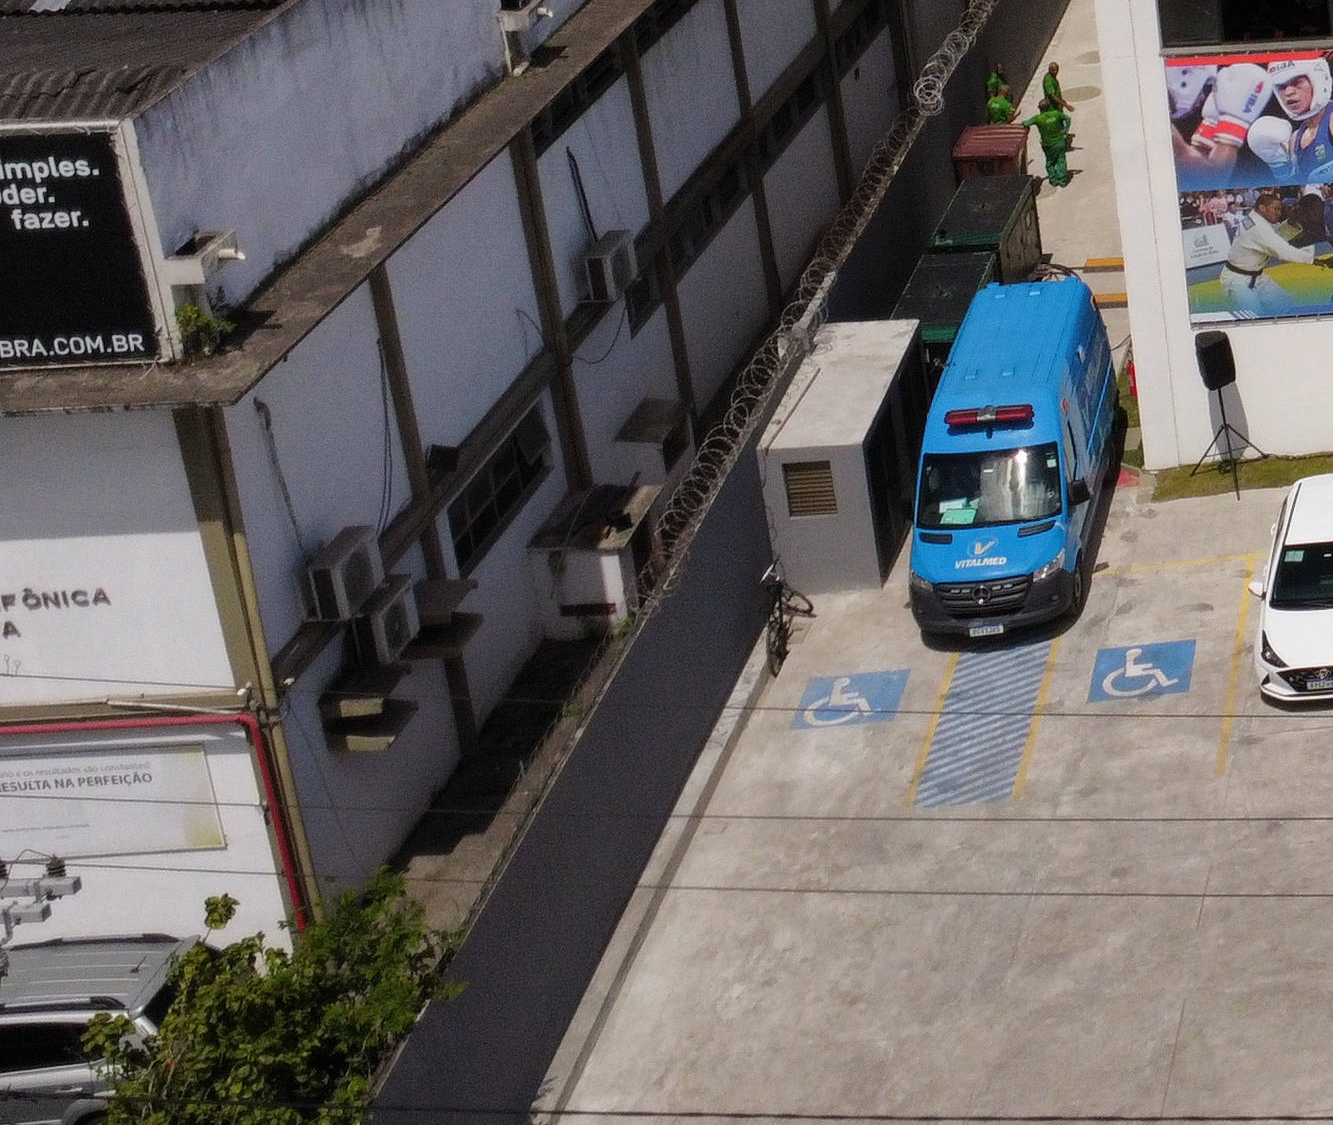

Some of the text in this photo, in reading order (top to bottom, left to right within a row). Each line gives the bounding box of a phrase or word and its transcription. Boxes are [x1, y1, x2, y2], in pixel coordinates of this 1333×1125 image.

[0, 157, 100, 182] imples.
[11, 209, 90, 230] fazer.
[955, 557, 1007, 569] VITALMED
[0, 772, 153, 793] ESULTA NA PERFEIÇÃO
